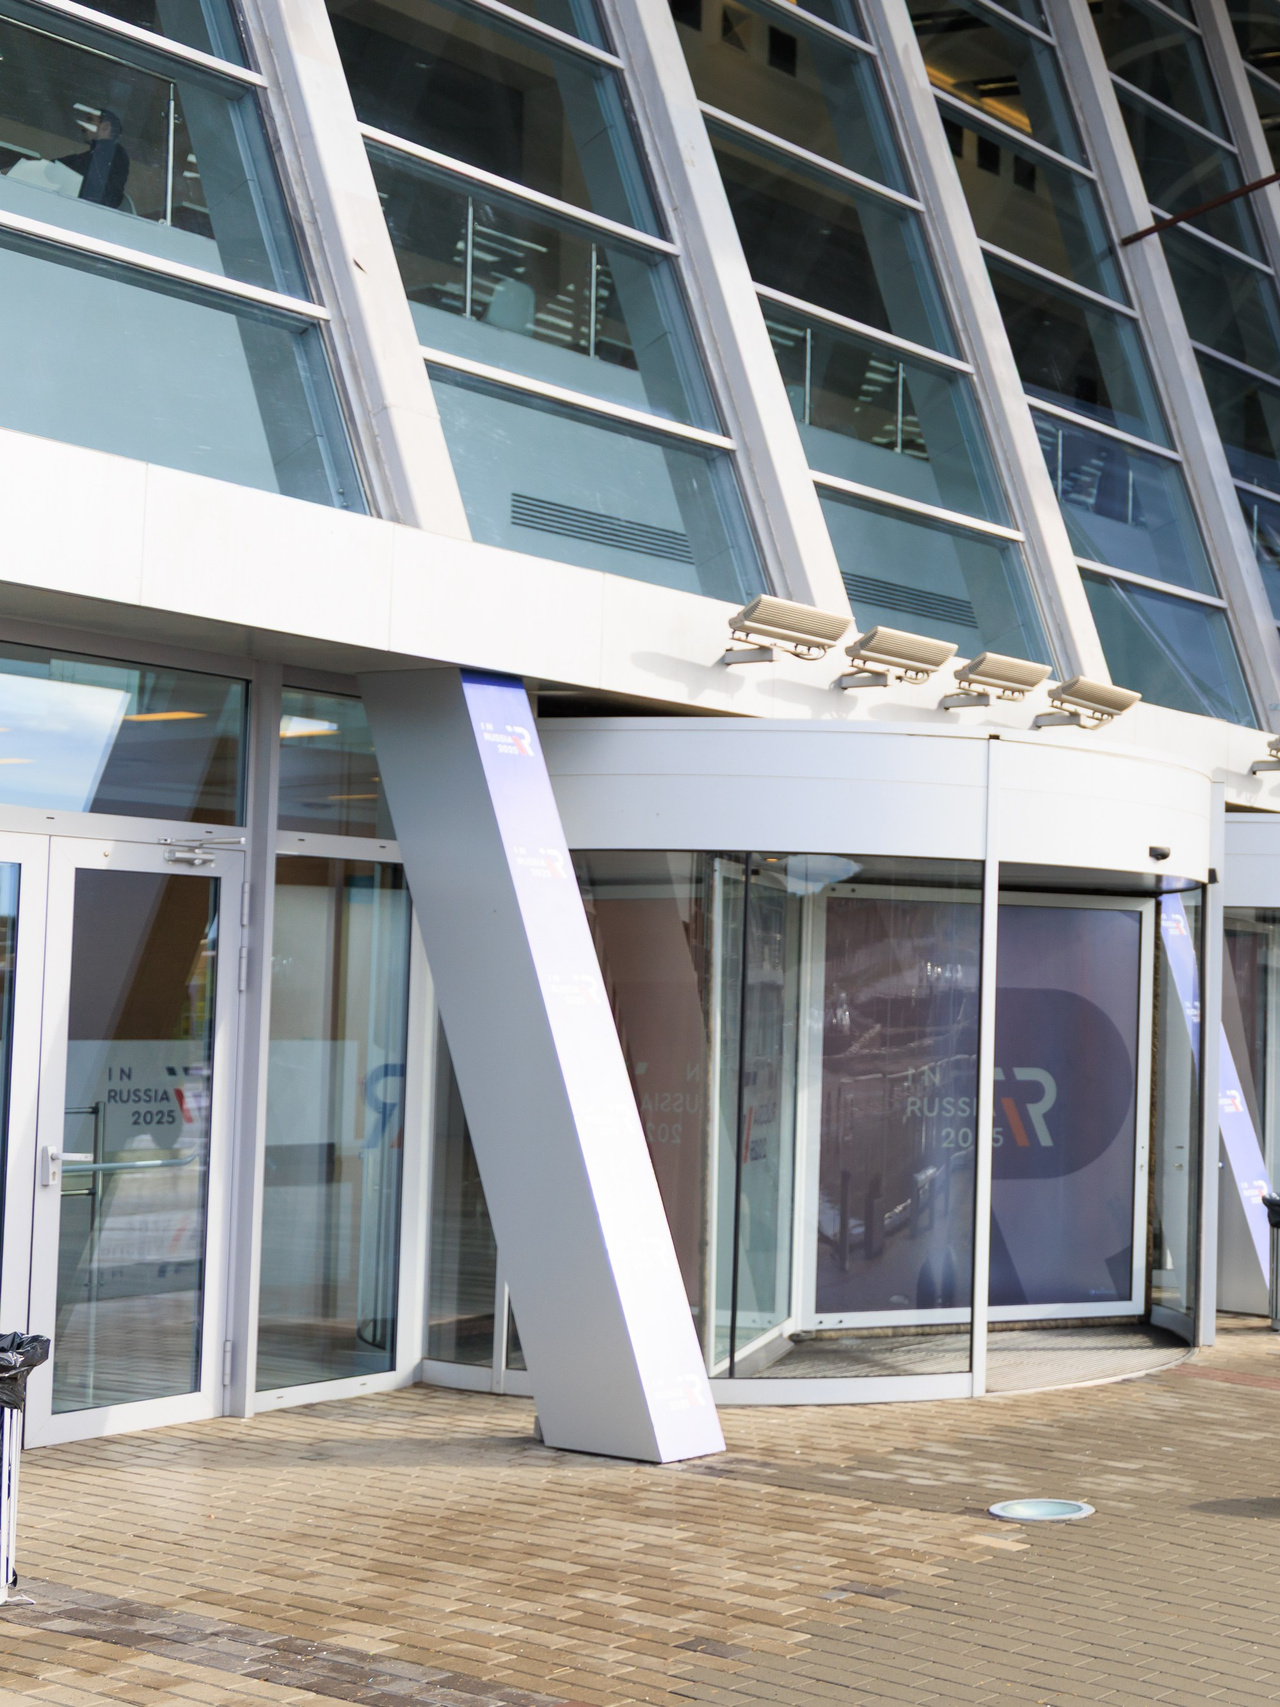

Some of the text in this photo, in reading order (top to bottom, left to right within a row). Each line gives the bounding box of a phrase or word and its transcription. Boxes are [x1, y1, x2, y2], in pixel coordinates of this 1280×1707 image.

[108, 1067, 132, 1081] IN
[107, 1083, 170, 1104] RUSSIA
[131, 1109, 176, 1126] 2025
[906, 1097, 996, 1118] RUSSI
[941, 1127, 1003, 1148] 205
